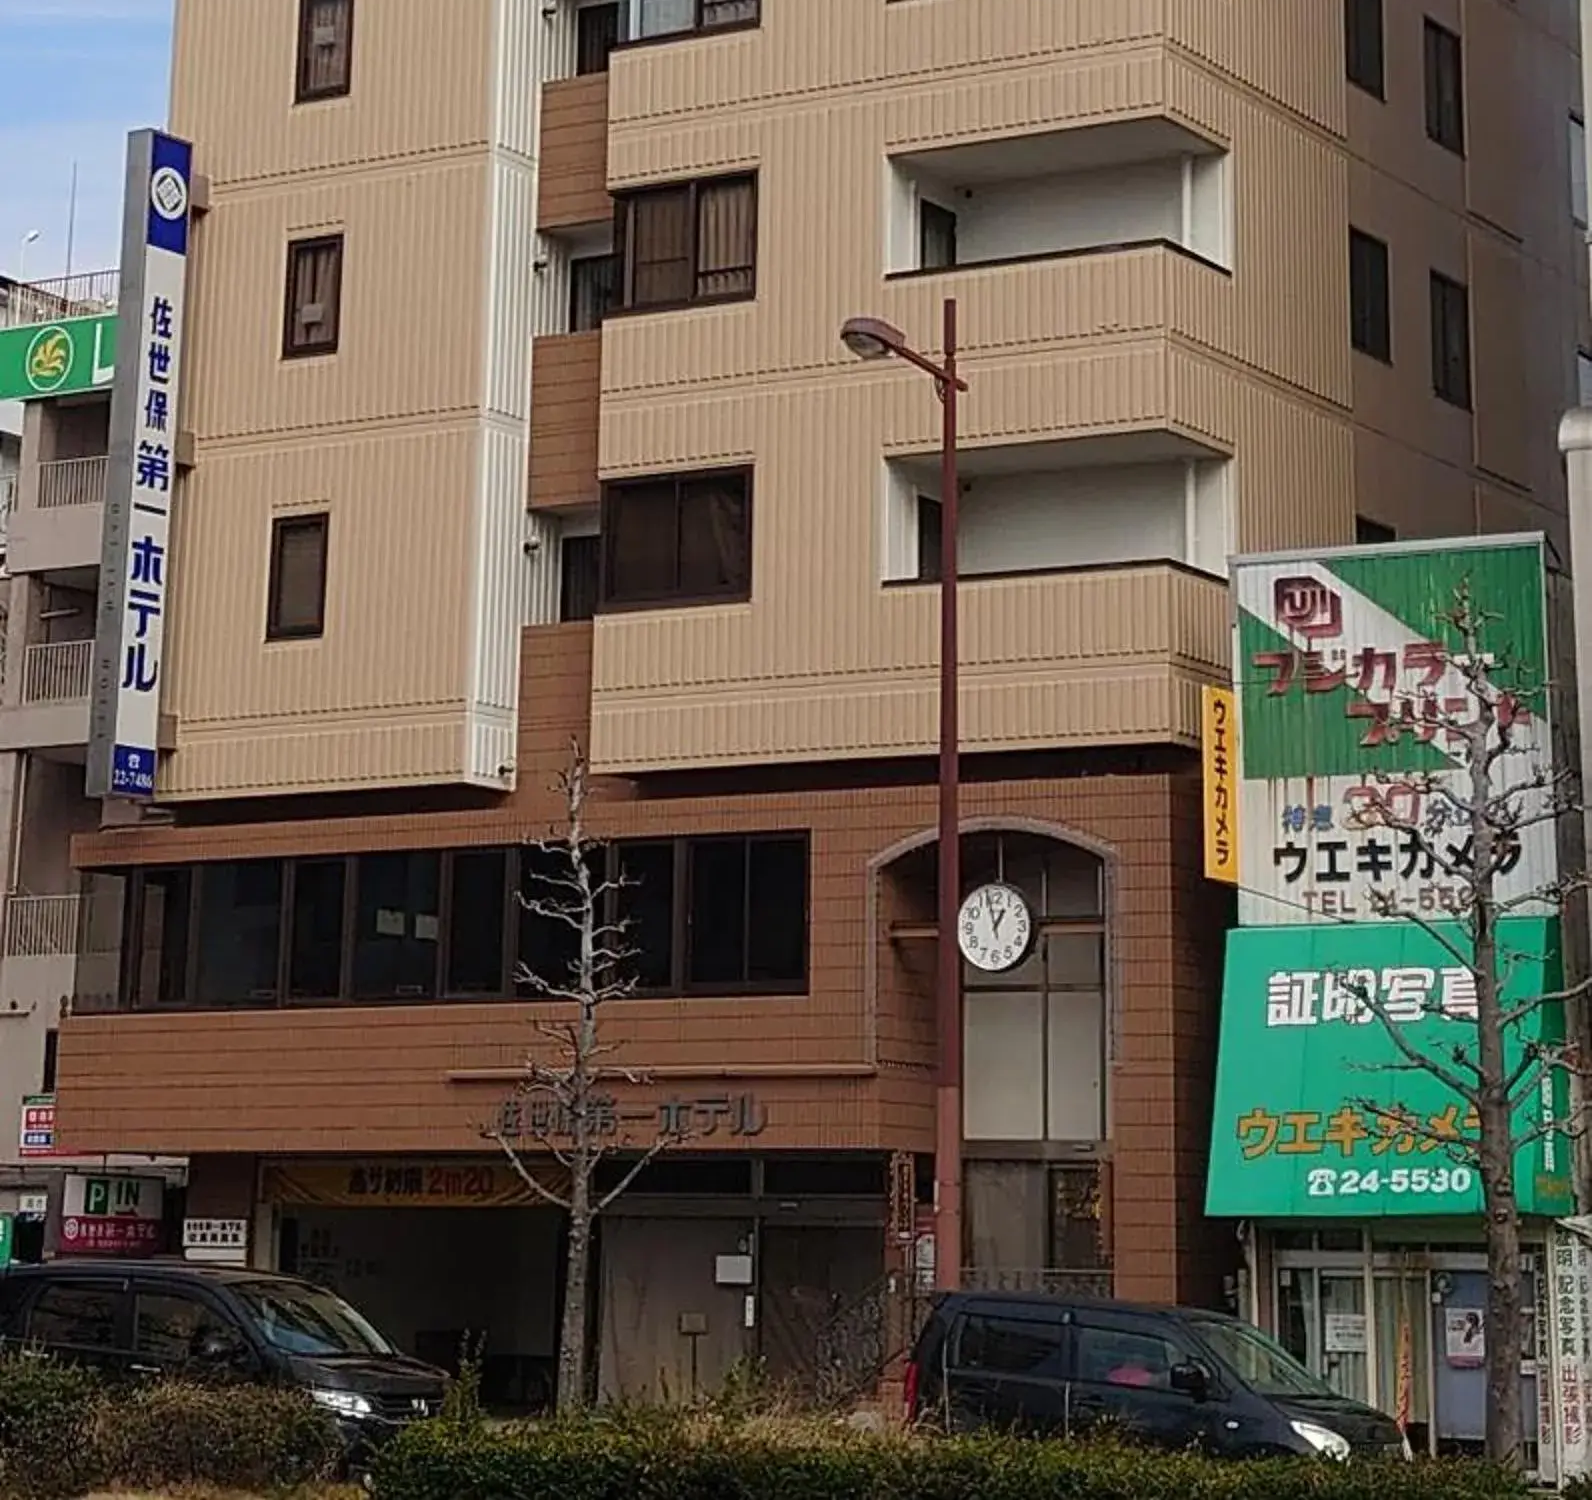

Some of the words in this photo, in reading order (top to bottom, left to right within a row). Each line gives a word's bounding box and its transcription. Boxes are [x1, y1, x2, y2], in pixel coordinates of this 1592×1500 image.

[1213, 699, 1229, 866] ウエキカメラ
[1303, 889, 1357, 914] TEL
[1267, 964, 1480, 1027] 証明写真
[89, 1183, 105, 1212] P
[116, 1180, 140, 1206] IN
[1339, 1168, 1471, 1194] 24-5530
